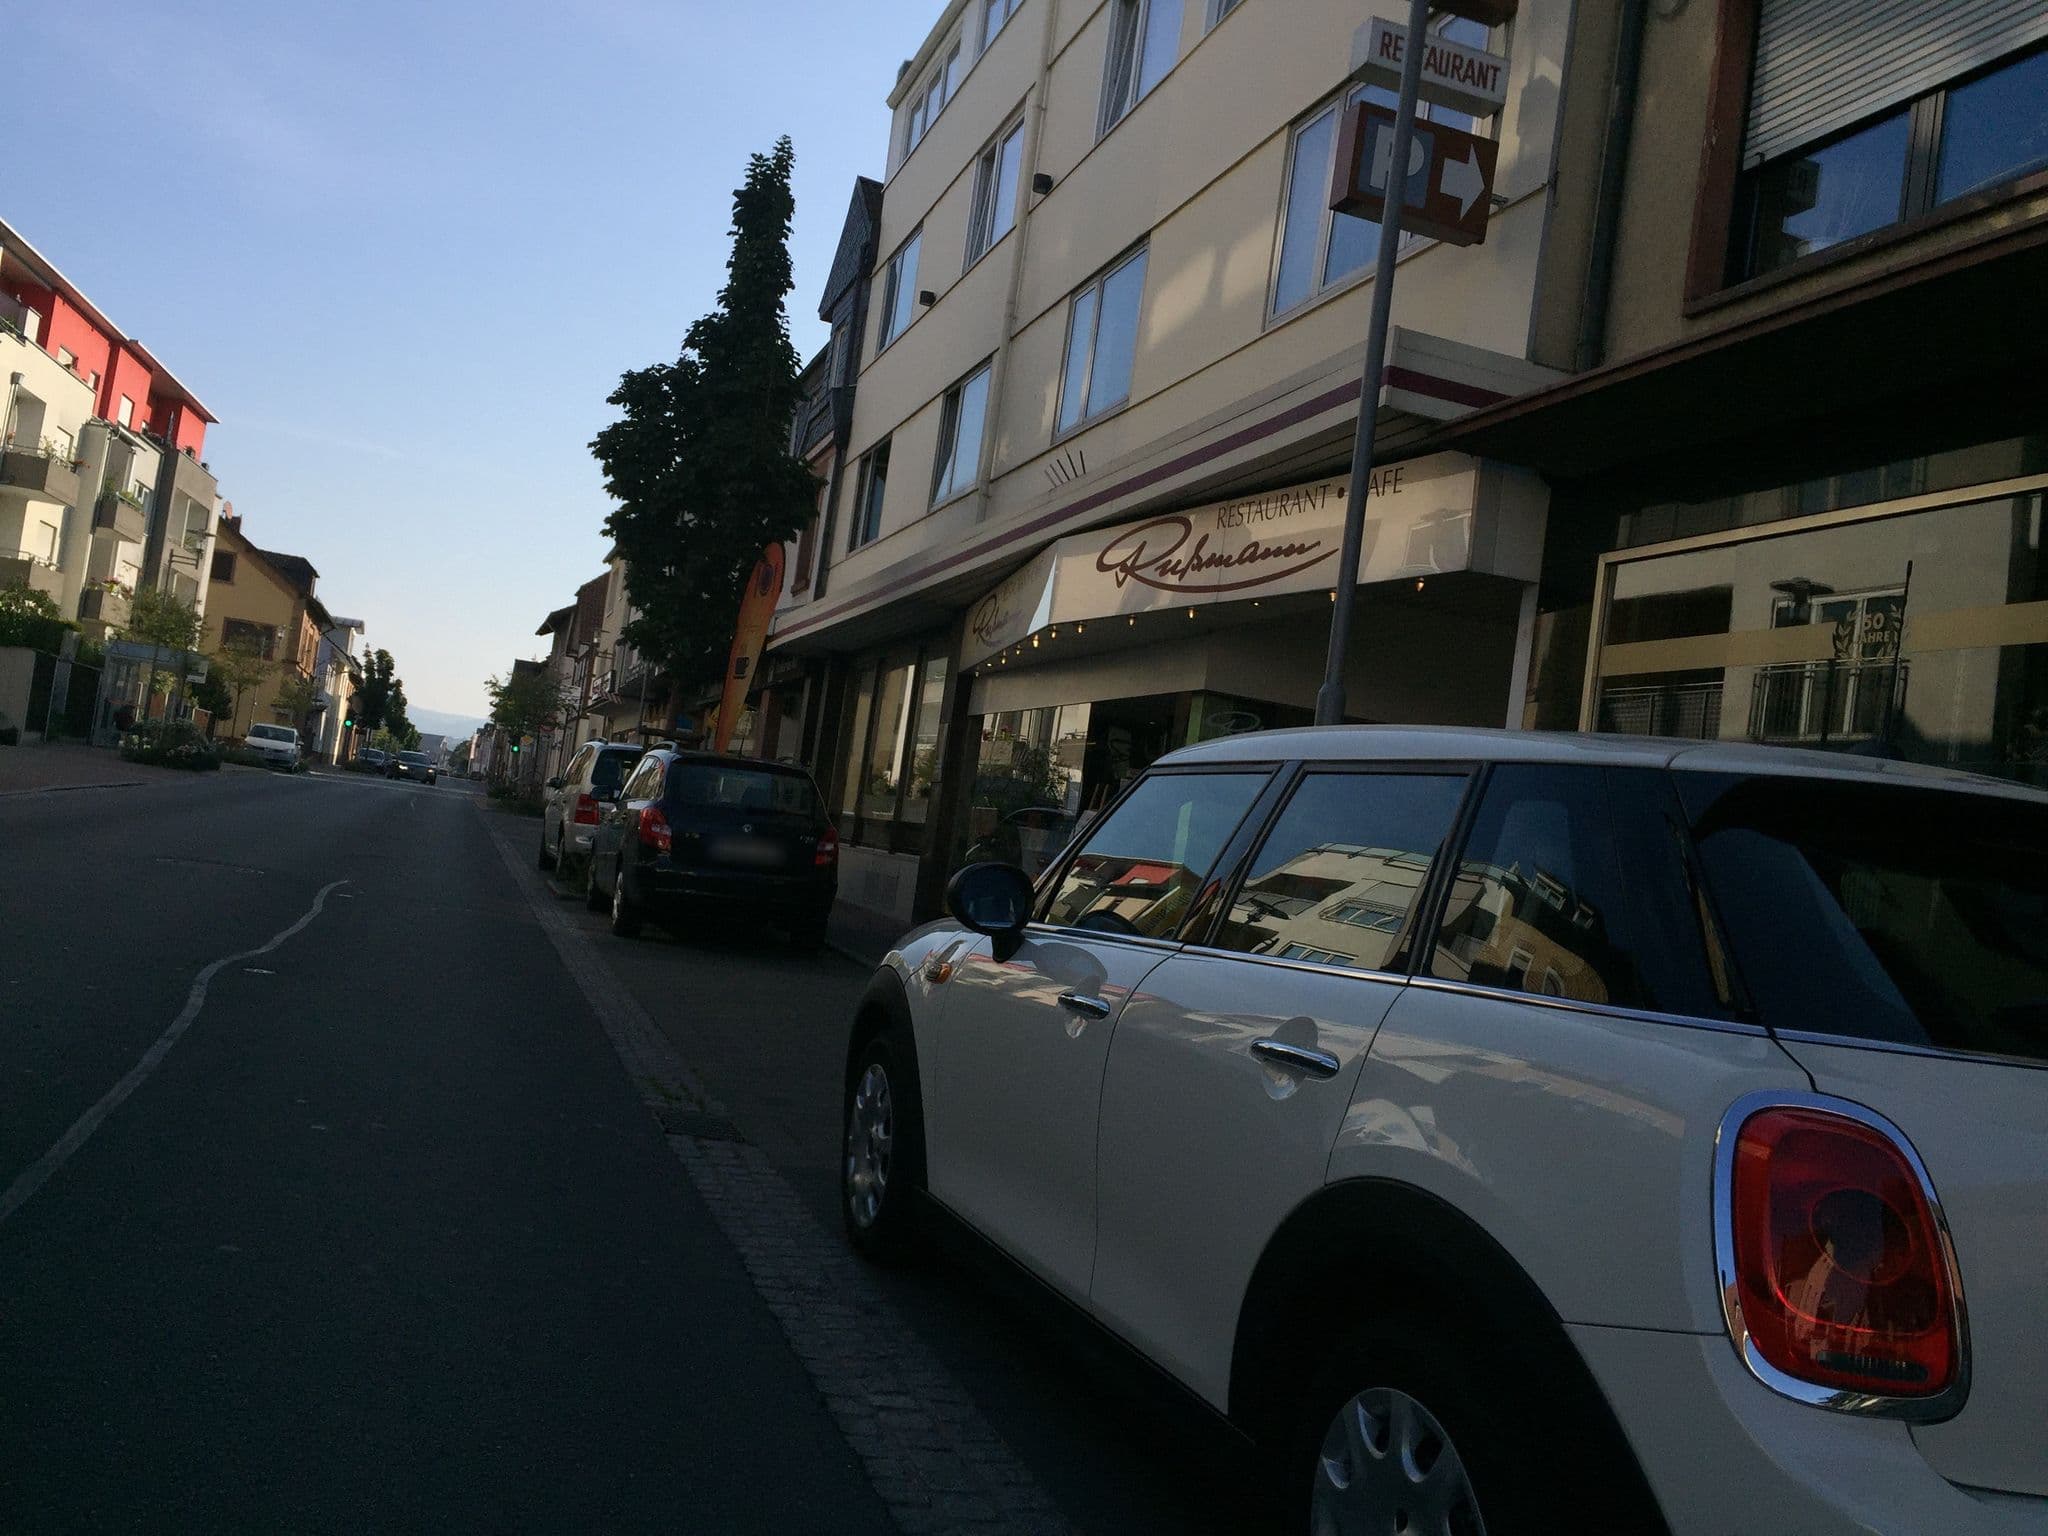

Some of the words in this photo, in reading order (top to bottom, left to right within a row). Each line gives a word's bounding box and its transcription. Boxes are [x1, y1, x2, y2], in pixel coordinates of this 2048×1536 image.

[1379, 31, 1501, 92] REAURANT
[1217, 484, 1331, 530] RESTAURANT
[1367, 466, 1405, 498] AFE
